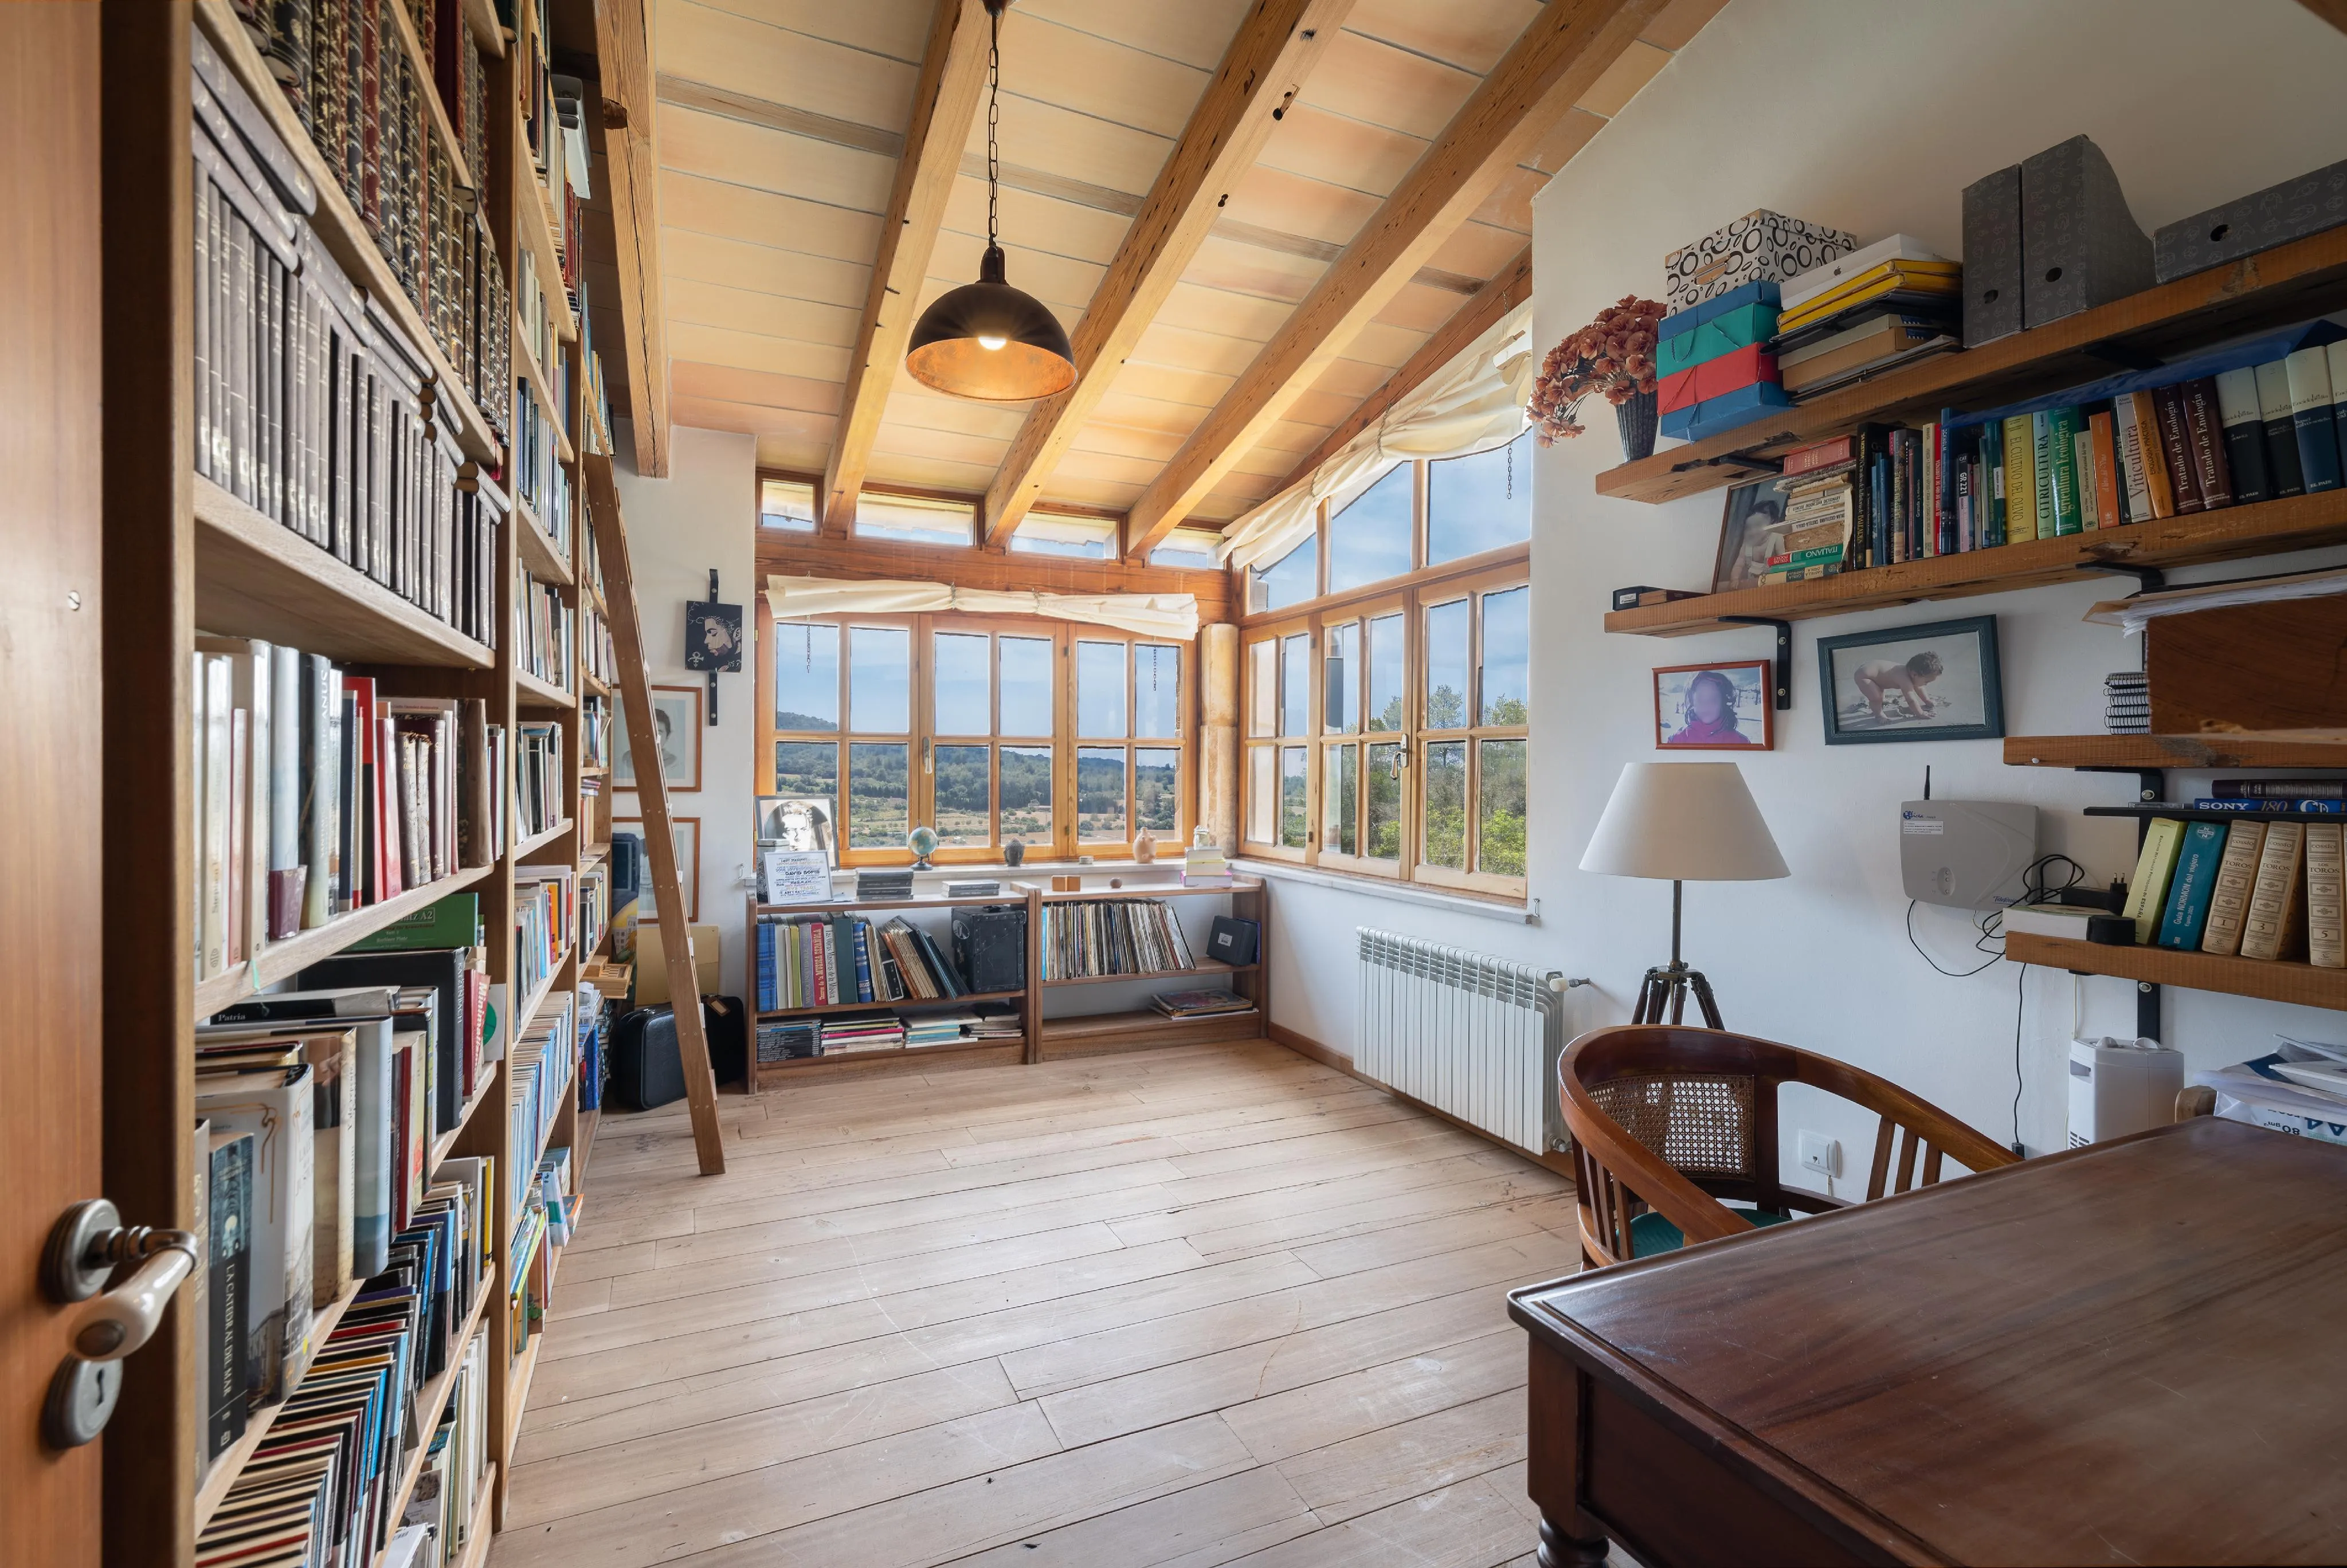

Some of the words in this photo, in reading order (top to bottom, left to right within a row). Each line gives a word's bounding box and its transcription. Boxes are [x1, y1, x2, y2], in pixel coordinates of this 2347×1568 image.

[2166, 401, 2180, 443] Enología
[2194, 393, 2207, 435] Enología
[2011, 436, 2021, 446] EL
[2174, 444, 2183, 456] de
[2200, 434, 2209, 447] de
[2011, 447, 2023, 480] CULTIVO
[2126, 425, 2145, 499] Viticultura
[2203, 449, 2216, 487] Tratado
[1960, 472, 1968, 482] GR
[2038, 434, 2050, 519] CITRICULTURA
[2176, 460, 2189, 493] Tratado
[2012, 481, 2023, 495] DEL
[2059, 465, 2075, 516] Agricultura
[2012, 497, 2024, 522] OLIVO
[1805, 545, 1837, 558] ITALIANO
[2199, 802, 2249, 810] SONY
[2224, 860, 2252, 869] TOROS
[2261, 862, 2291, 871] TOROS
[2177, 883, 2191, 911] NORMON
[2188, 853, 2199, 873] viajero
[1993, 896, 2020, 905] Telefónic
[2259, 923, 2265, 931] 3
[2321, 931, 2329, 939] 5
[2282, 1125, 2300, 1135] 80
[225, 1264, 235, 1283] LA
[225, 1283, 234, 1346] CATEDRAL
[224, 1344, 233, 1369] DEL
[223, 1366, 233, 1397] MAR
